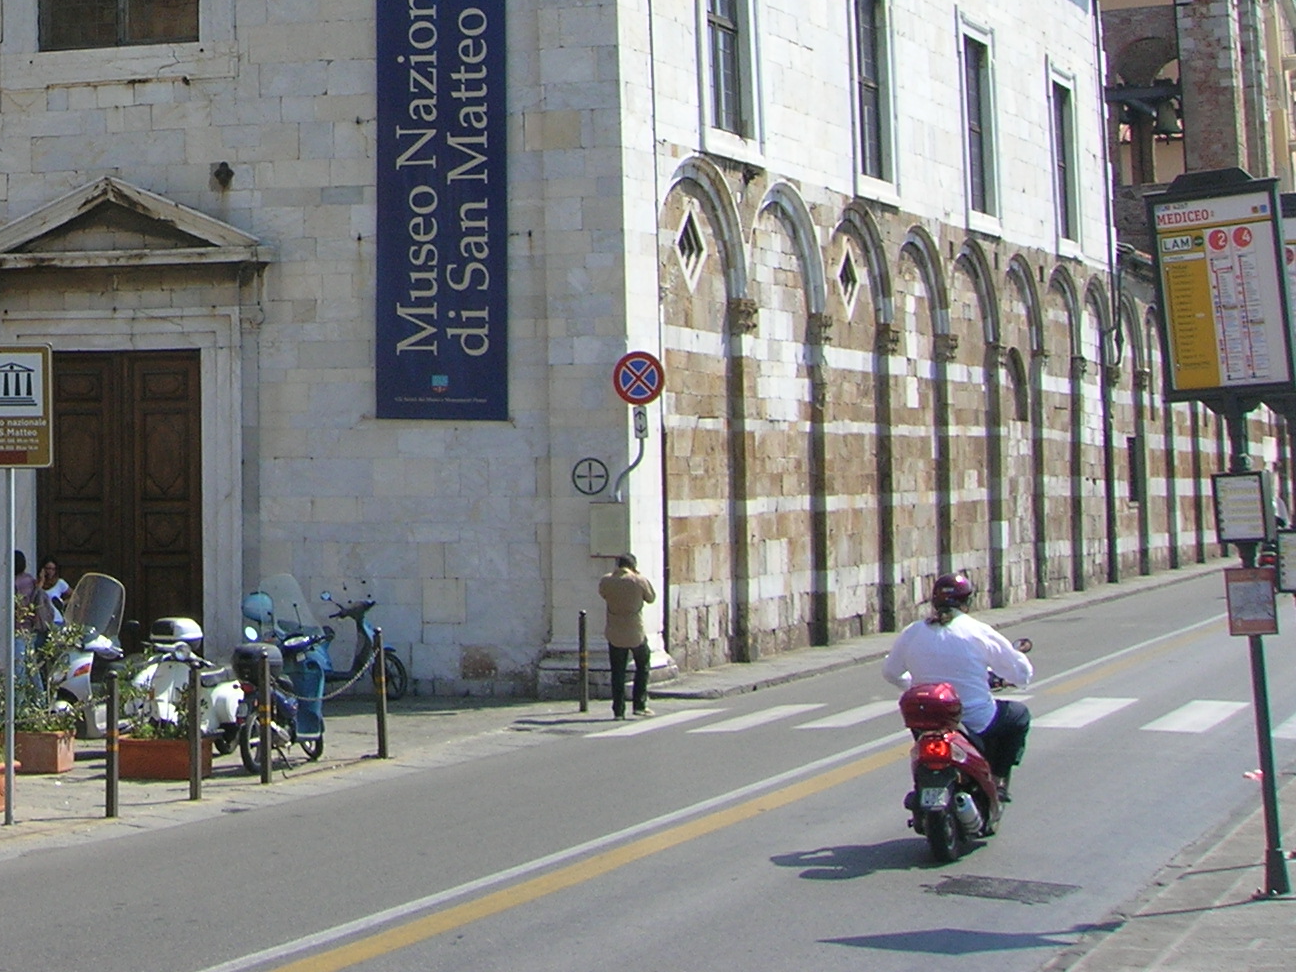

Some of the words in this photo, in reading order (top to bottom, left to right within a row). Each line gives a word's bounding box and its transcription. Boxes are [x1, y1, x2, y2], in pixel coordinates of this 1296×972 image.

[446, 6, 488, 185] Matteo
[1156, 209, 1209, 226] MEDICEO
[446, 198, 489, 291] San
[1163, 237, 1190, 250] LAM
[1218, 232, 1226, 246] 2
[396, 185, 438, 357] Museo
[446, 306, 489, 357] di
[7, 417, 47, 427] nazionale
